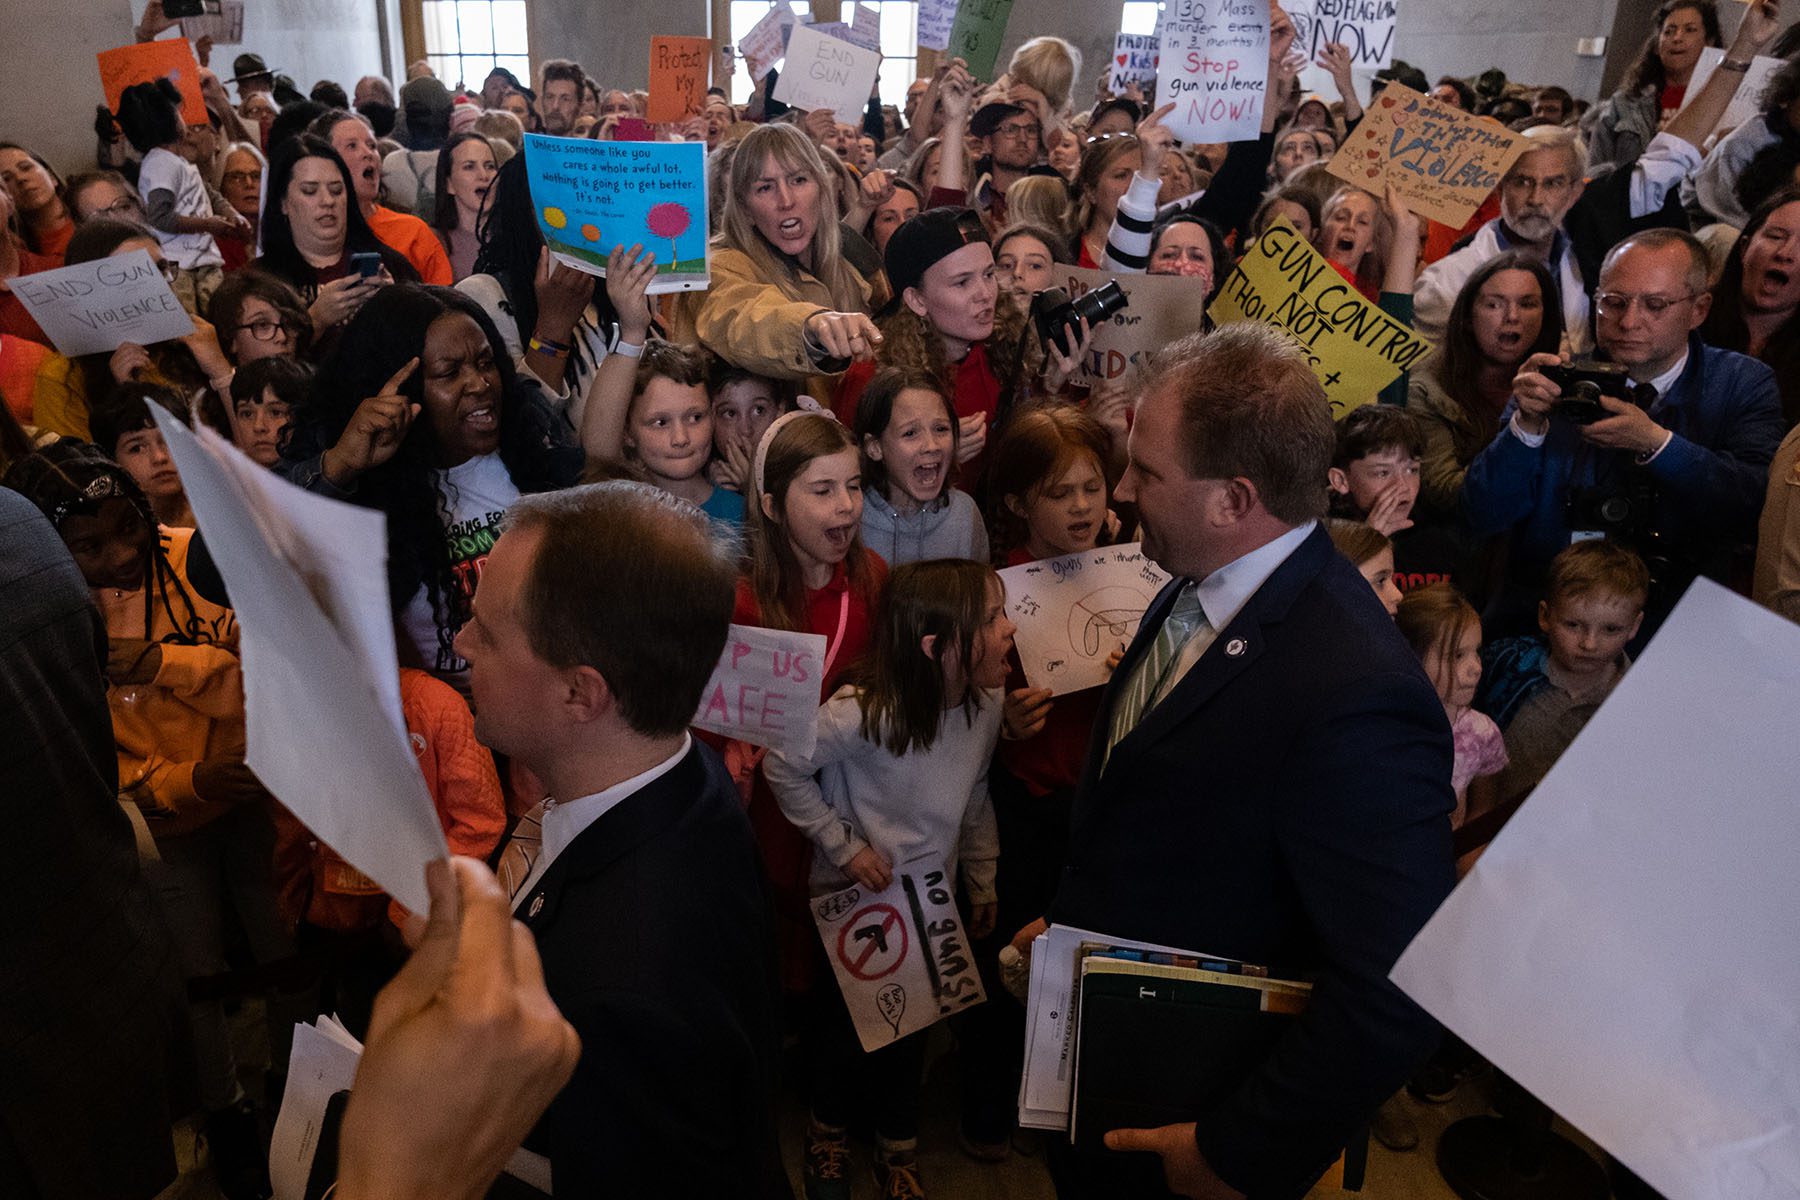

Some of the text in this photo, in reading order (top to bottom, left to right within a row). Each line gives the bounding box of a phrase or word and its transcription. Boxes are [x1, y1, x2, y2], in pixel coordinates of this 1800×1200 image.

[816, 41, 855, 67] END
[1117, 34, 1160, 50] PROTEC
[1168, 37, 1180, 48] in
[1190, 35, 1200, 47] 3
[1310, 19, 1395, 63] NOW
[809, 61, 849, 86] GUN
[1183, 52, 1240, 80] Stop
[1168, 76, 1264, 98] gun violence
[1187, 96, 1255, 125] NOW!
[532, 140, 651, 160] Unless someone like you
[563, 161, 588, 171] cares
[599, 162, 628, 174] whole
[632, 163, 661, 174] awful
[664, 164, 682, 174] lot.
[542, 173, 696, 193] Nothing is going to get better.
[575, 192, 592, 203] It's
[18, 260, 155, 306] END GUN
[71, 294, 177, 329] VIOLENCE
[1260, 226, 1429, 373] GUN CONTROL
[1275, 291, 1335, 346] NOT
[773, 650, 813, 683] US
[703, 682, 787, 732] AFE
